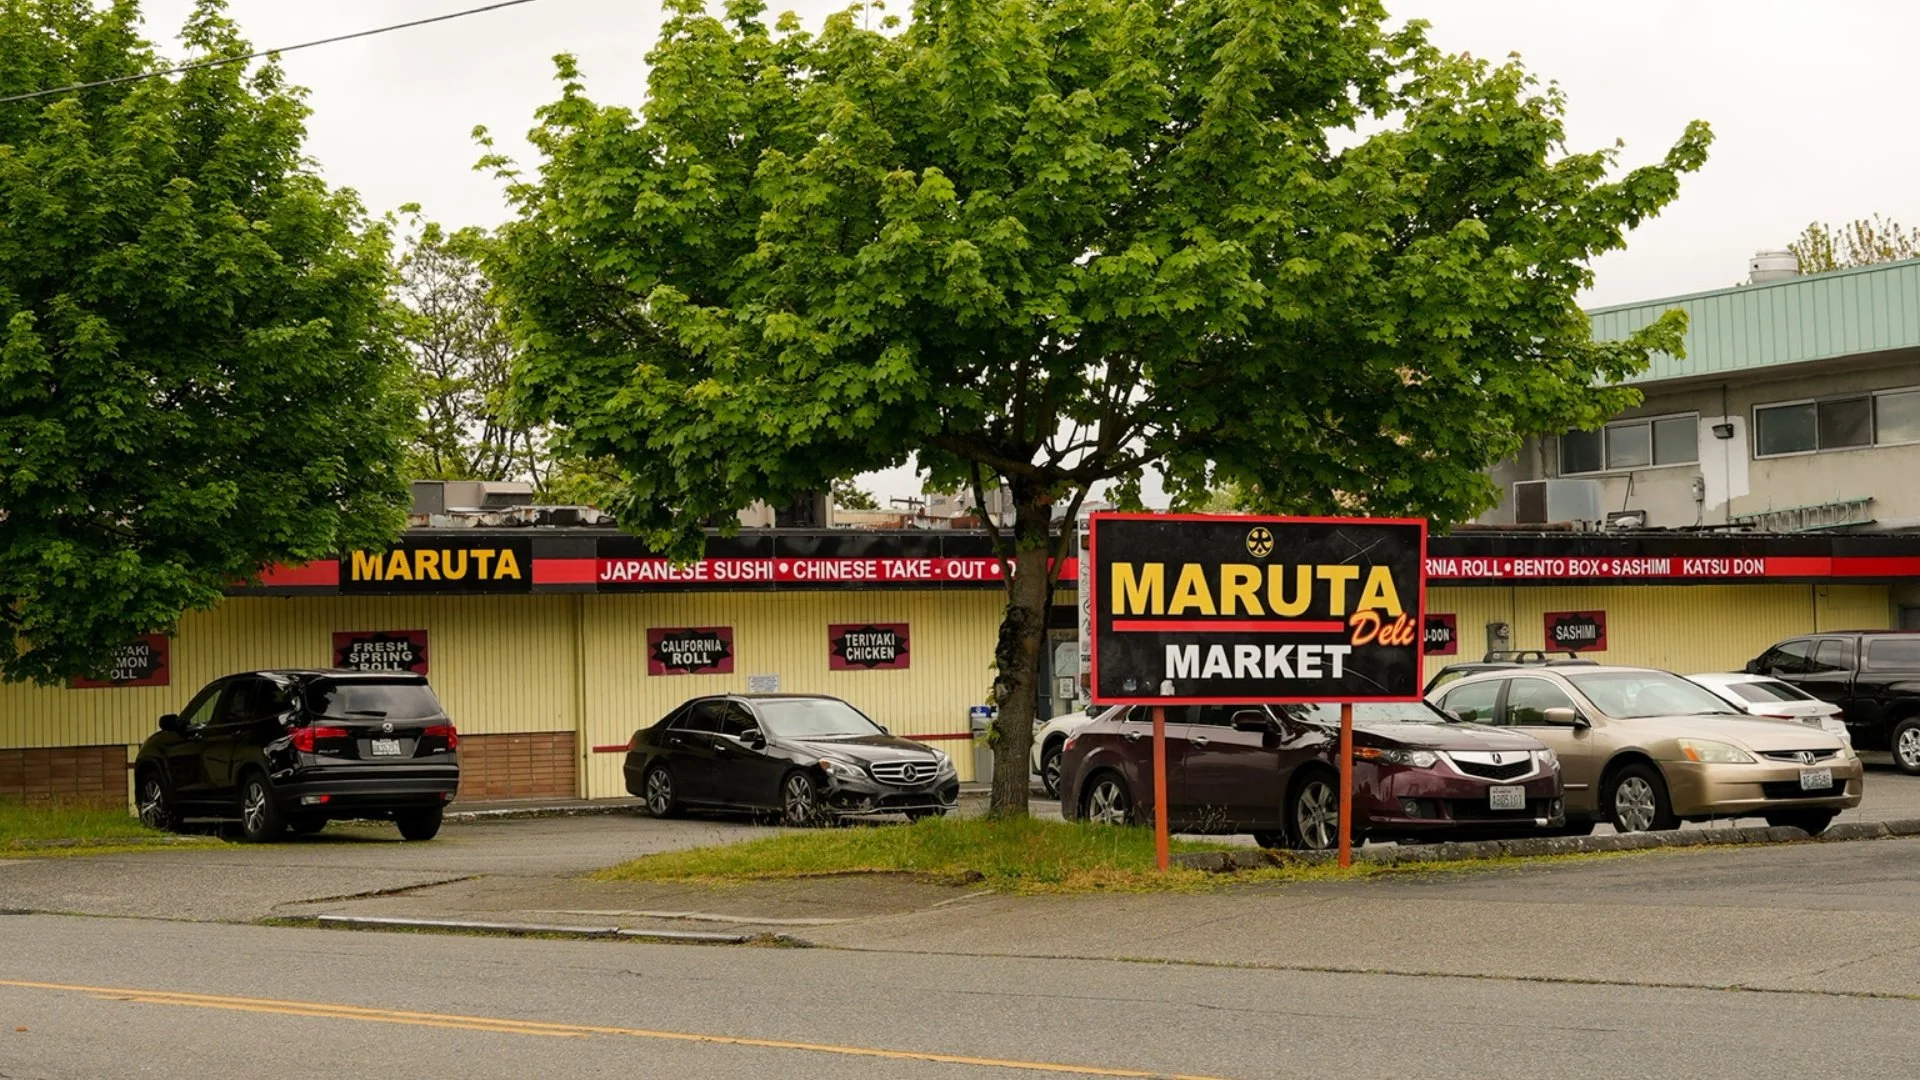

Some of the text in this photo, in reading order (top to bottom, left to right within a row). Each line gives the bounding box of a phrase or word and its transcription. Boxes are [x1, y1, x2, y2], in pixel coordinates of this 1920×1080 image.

[352, 549, 522, 581] MARUTA
[601, 561, 708, 580] JAPANESE
[714, 561, 773, 580] SUSHI
[793, 560, 877, 579] CHINESE
[1425, 559, 1764, 576] RNIA ROLL BENTO BOX SASHIMI KATSU DON
[1111, 562, 1404, 617] MARUTA
[1349, 609, 1416, 646] Deli
[1556, 624, 1596, 641] SASHIMI
[845, 633, 895, 647] TERIYAKI
[1423, 628, 1450, 642] U-DON
[353, 641, 408, 652] FRESH
[661, 639, 722, 652] CALIFORNIA
[349, 651, 413, 663] SPRING
[672, 652, 711, 665] ROLL
[846, 647, 894, 660] CHICKEN
[116, 656, 148, 668] MON
[360, 662, 402, 671] ROLL
[1165, 644, 1352, 680] MARKET
[110, 669, 137, 680] OLL
